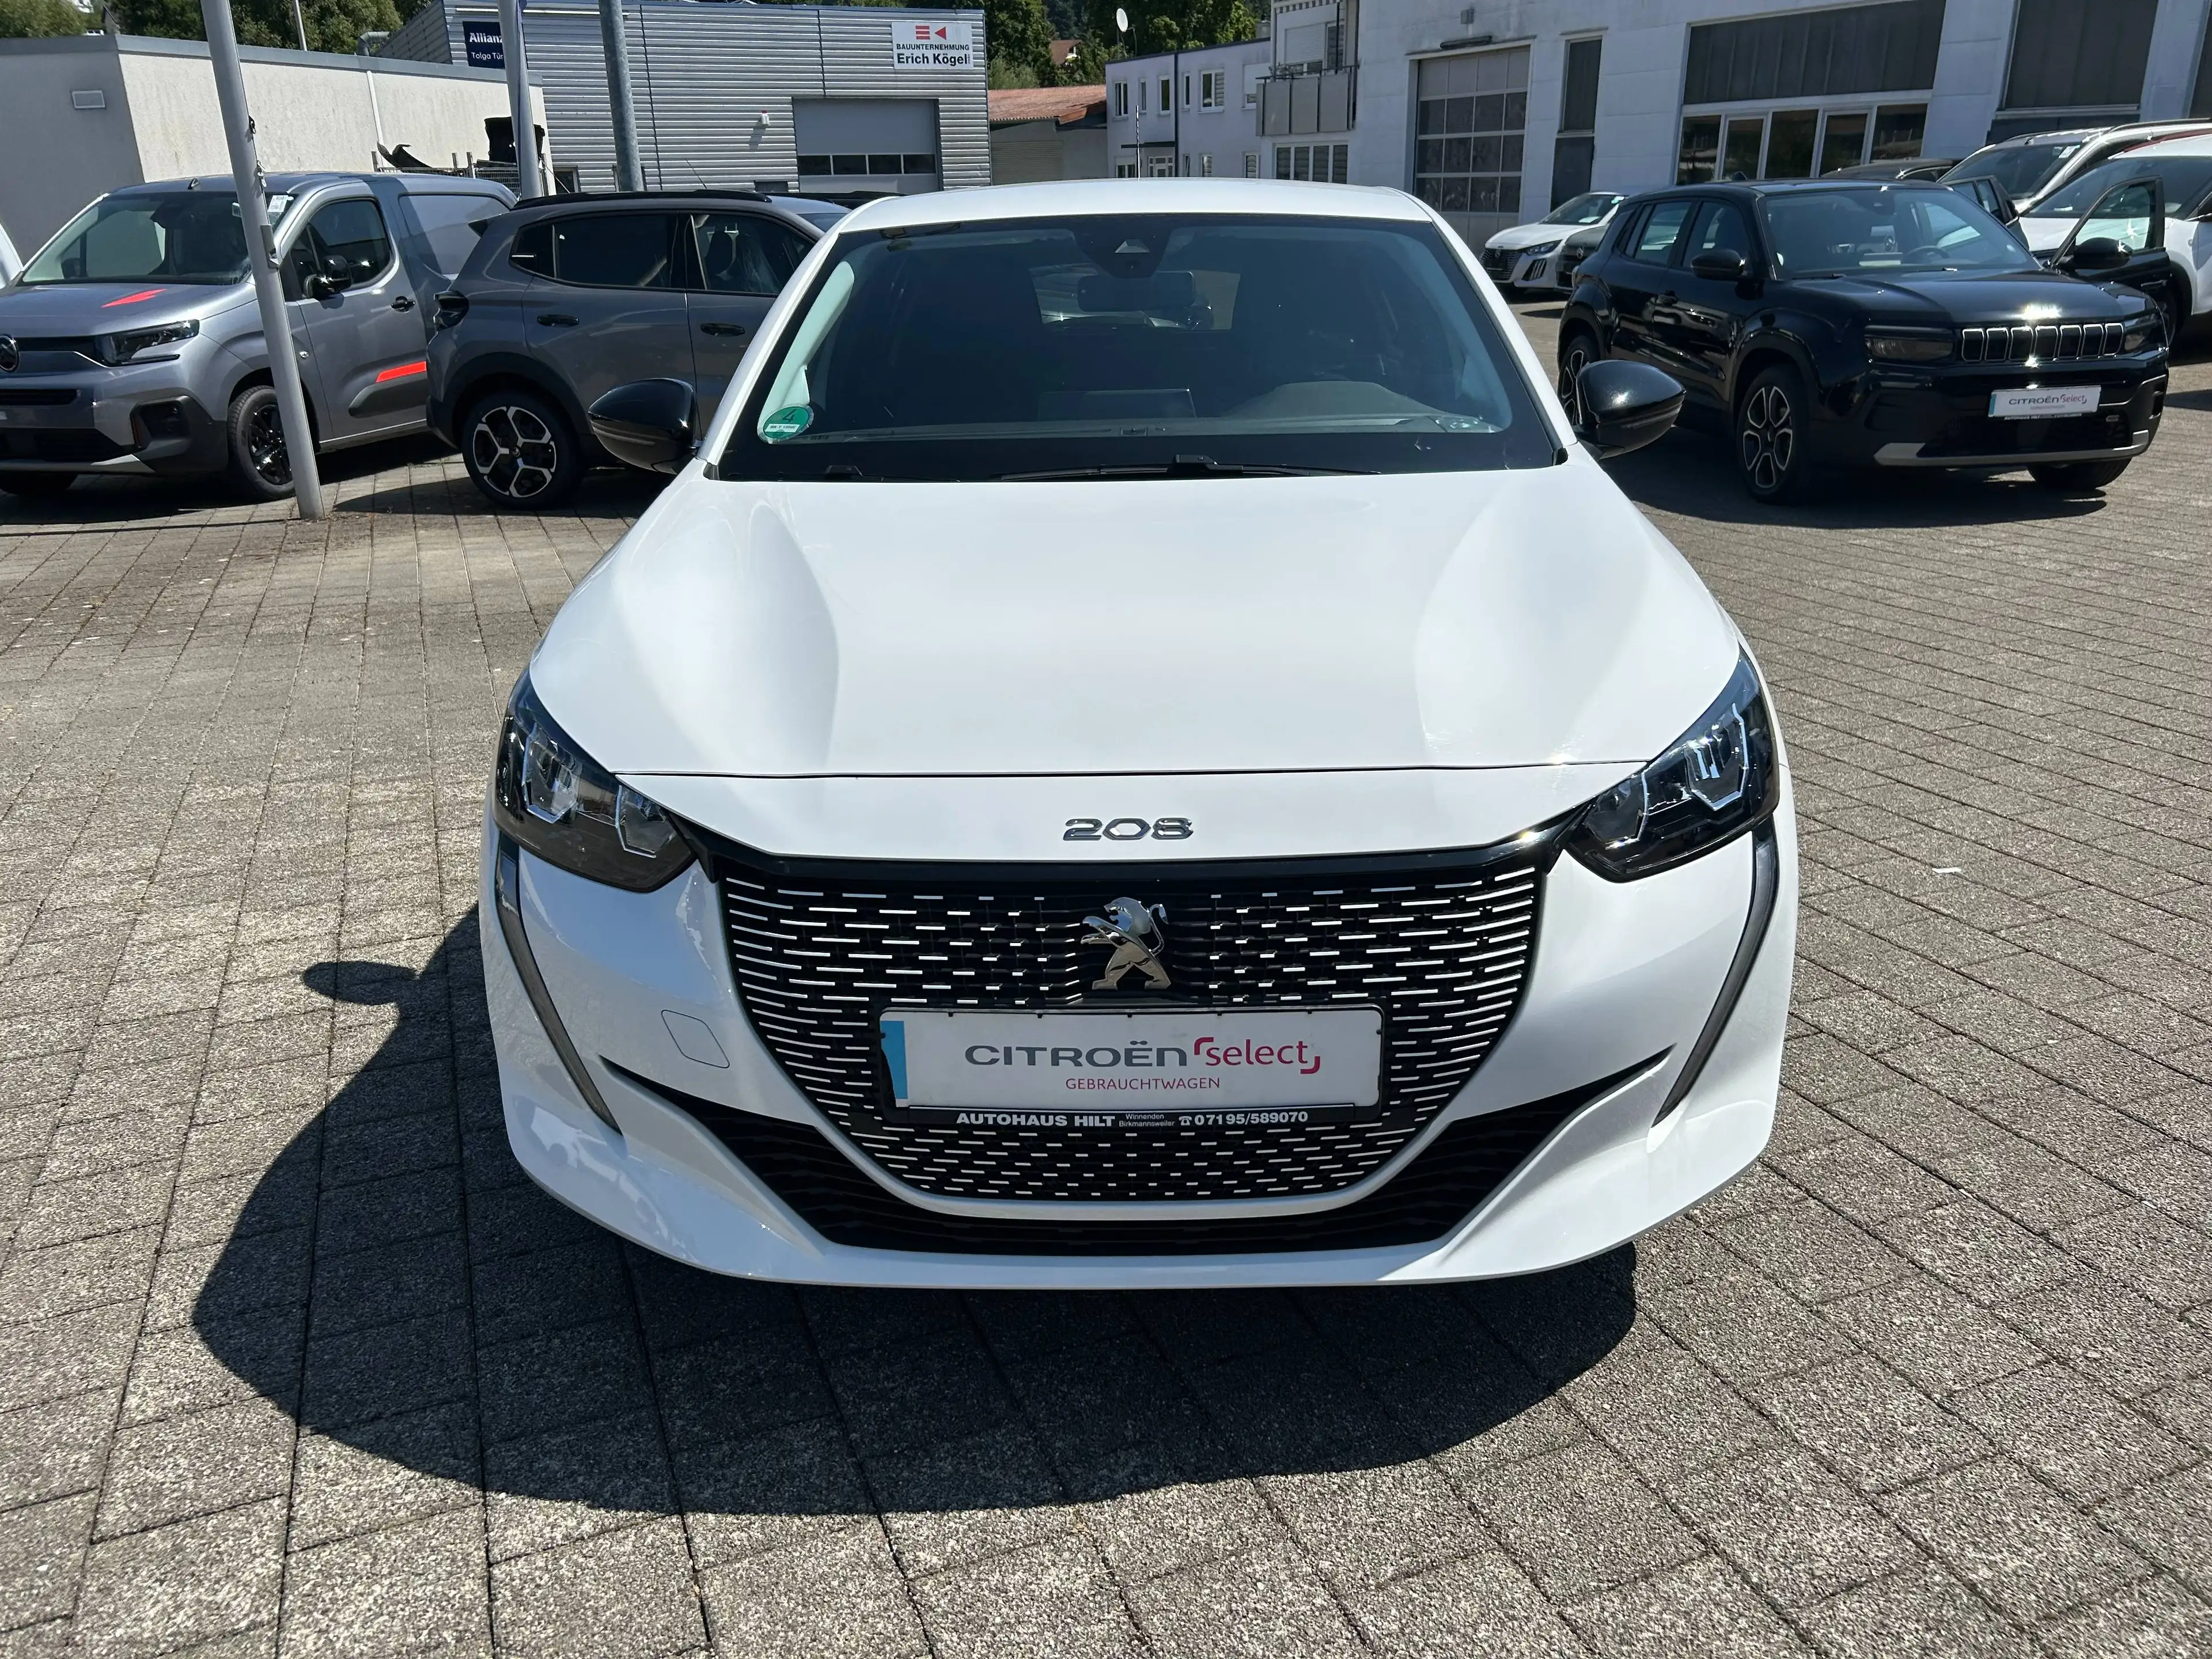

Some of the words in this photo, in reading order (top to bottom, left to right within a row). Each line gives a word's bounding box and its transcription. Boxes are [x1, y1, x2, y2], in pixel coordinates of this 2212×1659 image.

[471, 52, 491, 60] Tolga
[897, 53, 929, 64] Erich
[933, 53, 968, 66] Kögel
[2062, 394, 2085, 403] select
[781, 408, 798, 422] 4
[1063, 817, 1194, 840] 208
[1205, 1039, 1308, 1066] select
[1066, 1077, 1220, 1090] GEBRAUCHTWAGEN
[956, 1113, 1067, 1127] AUTOHAUS
[1074, 1116, 1115, 1127] HILT
[1194, 1111, 1308, 1126] 07195/589070
